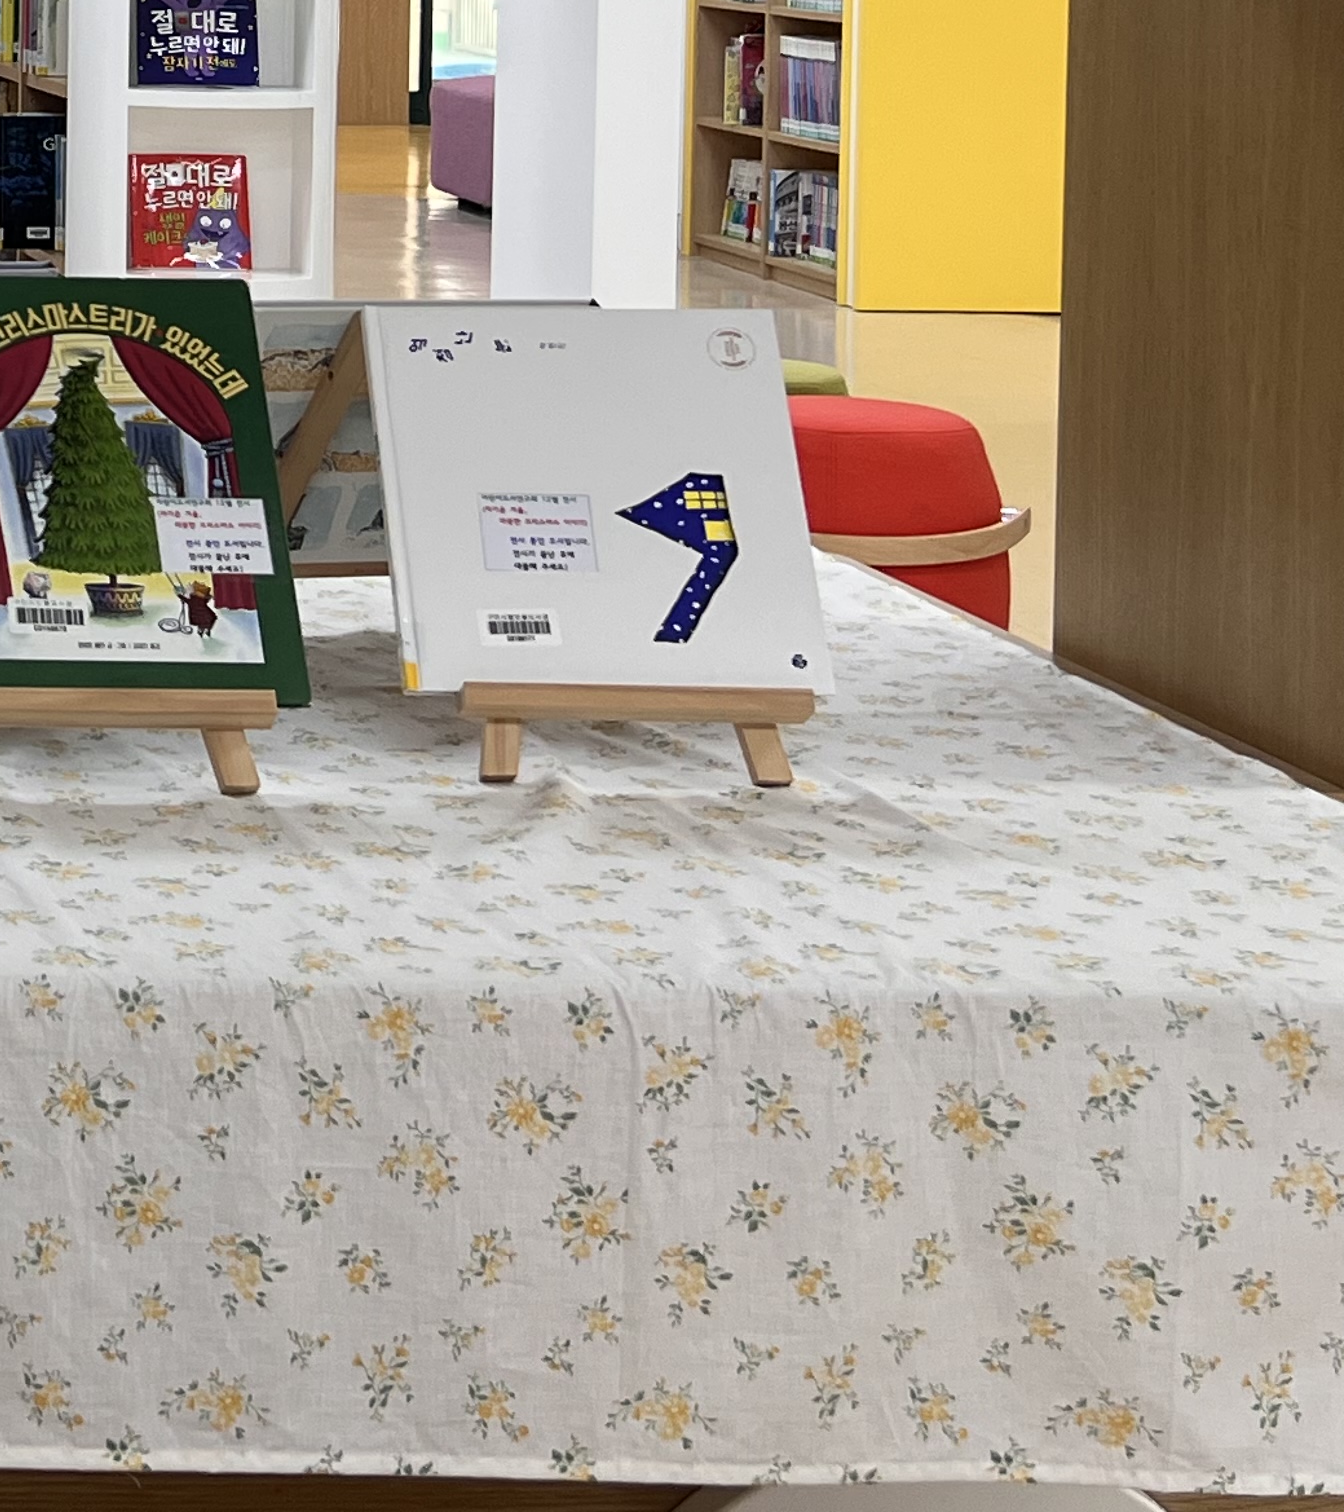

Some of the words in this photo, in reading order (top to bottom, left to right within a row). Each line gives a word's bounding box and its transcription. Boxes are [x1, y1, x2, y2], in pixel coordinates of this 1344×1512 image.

[150, 35, 200, 57] 누르면
[144, 190, 194, 211] 누르면
[144, 230, 184, 245] 케이크
[160, 324, 249, 399] 있었는데
